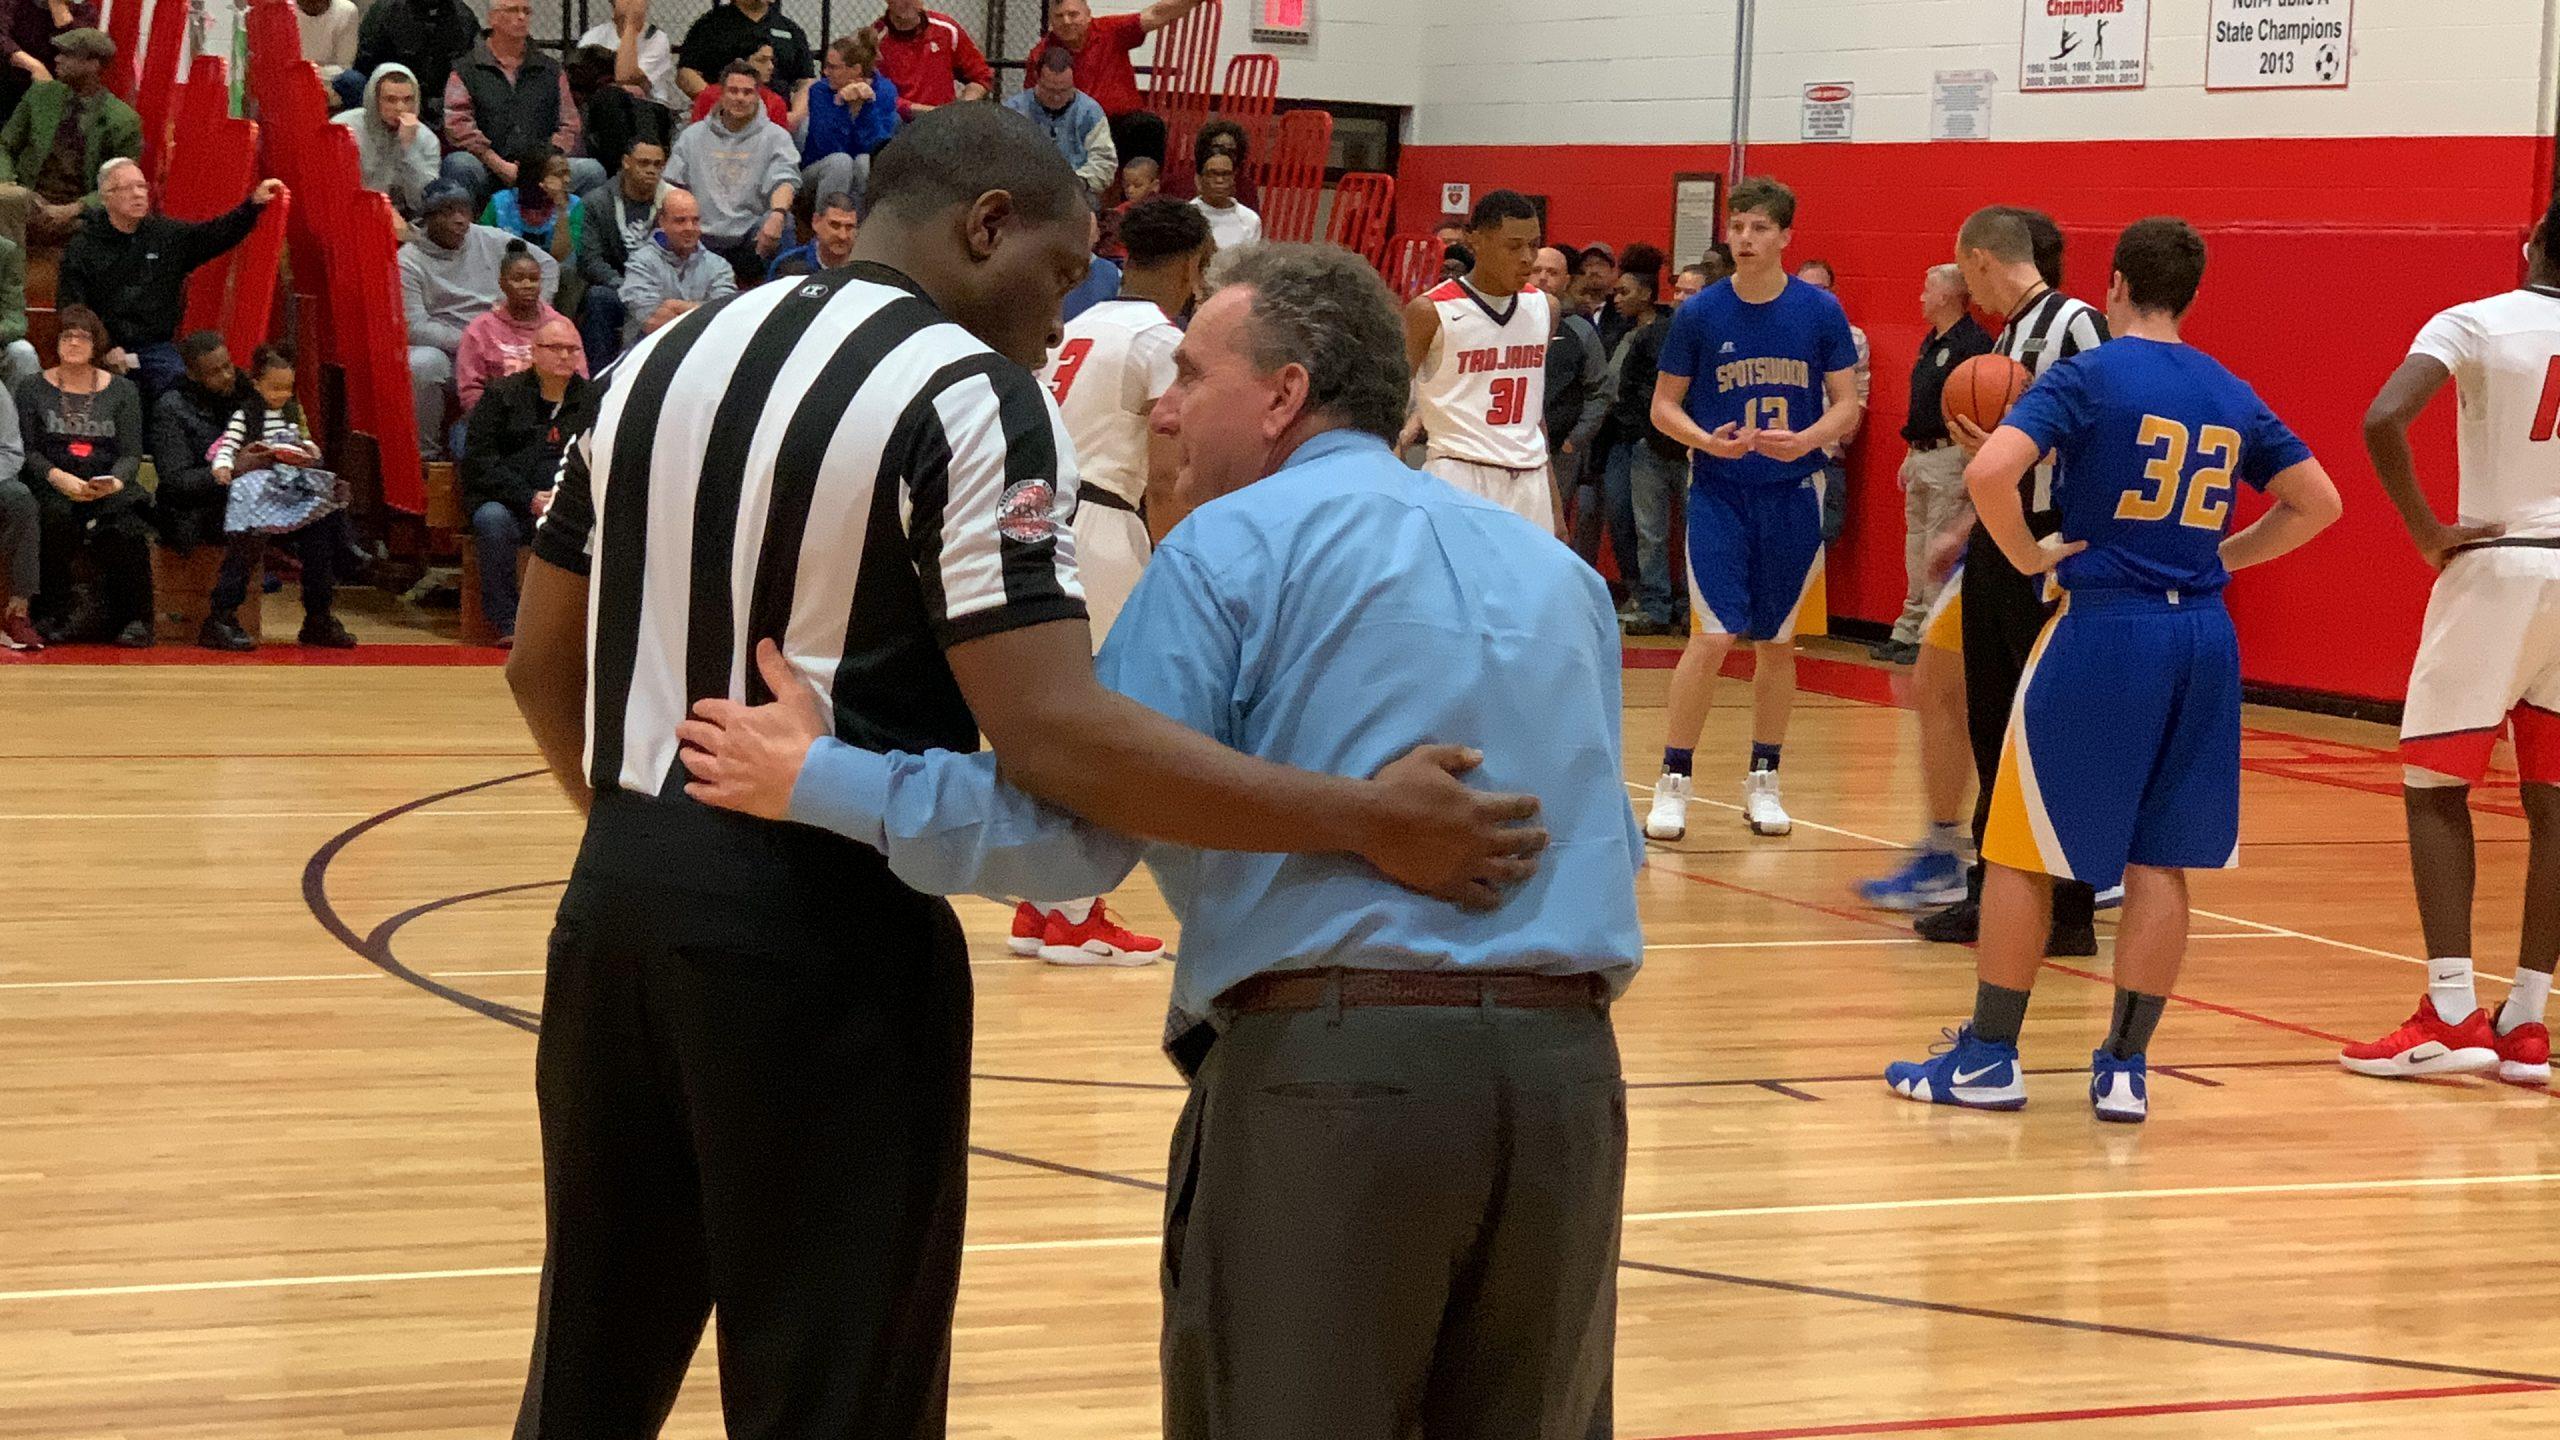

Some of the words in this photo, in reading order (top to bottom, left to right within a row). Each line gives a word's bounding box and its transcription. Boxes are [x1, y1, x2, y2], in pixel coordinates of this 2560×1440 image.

[2216, 20, 2254, 43] State
[2258, 16, 2343, 45] Champions
[2259, 51, 2294, 74] 2013
[1457, 344, 1545, 375] TROJANS
[1716, 356, 1809, 394] SPOTSWOOD
[1485, 376, 1528, 426] 31
[2113, 413, 2242, 531] 32
